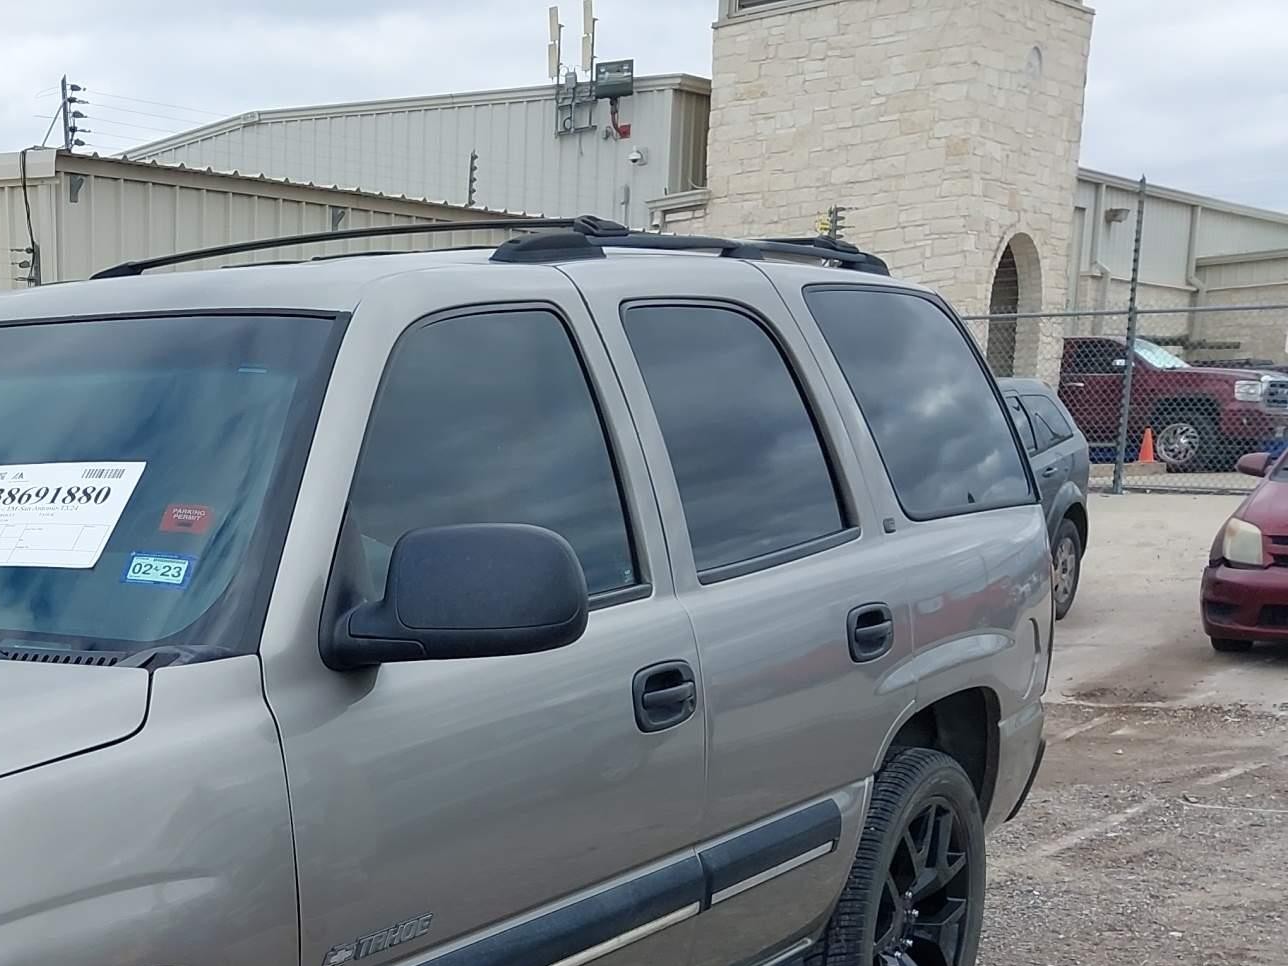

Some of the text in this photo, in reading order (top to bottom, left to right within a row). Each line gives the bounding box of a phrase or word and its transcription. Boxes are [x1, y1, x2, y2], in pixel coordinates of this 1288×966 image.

[172, 508, 206, 516] PARKING
[132, 563, 182, 578] 02 23
[356, 912, 433, 959] TAHOE
